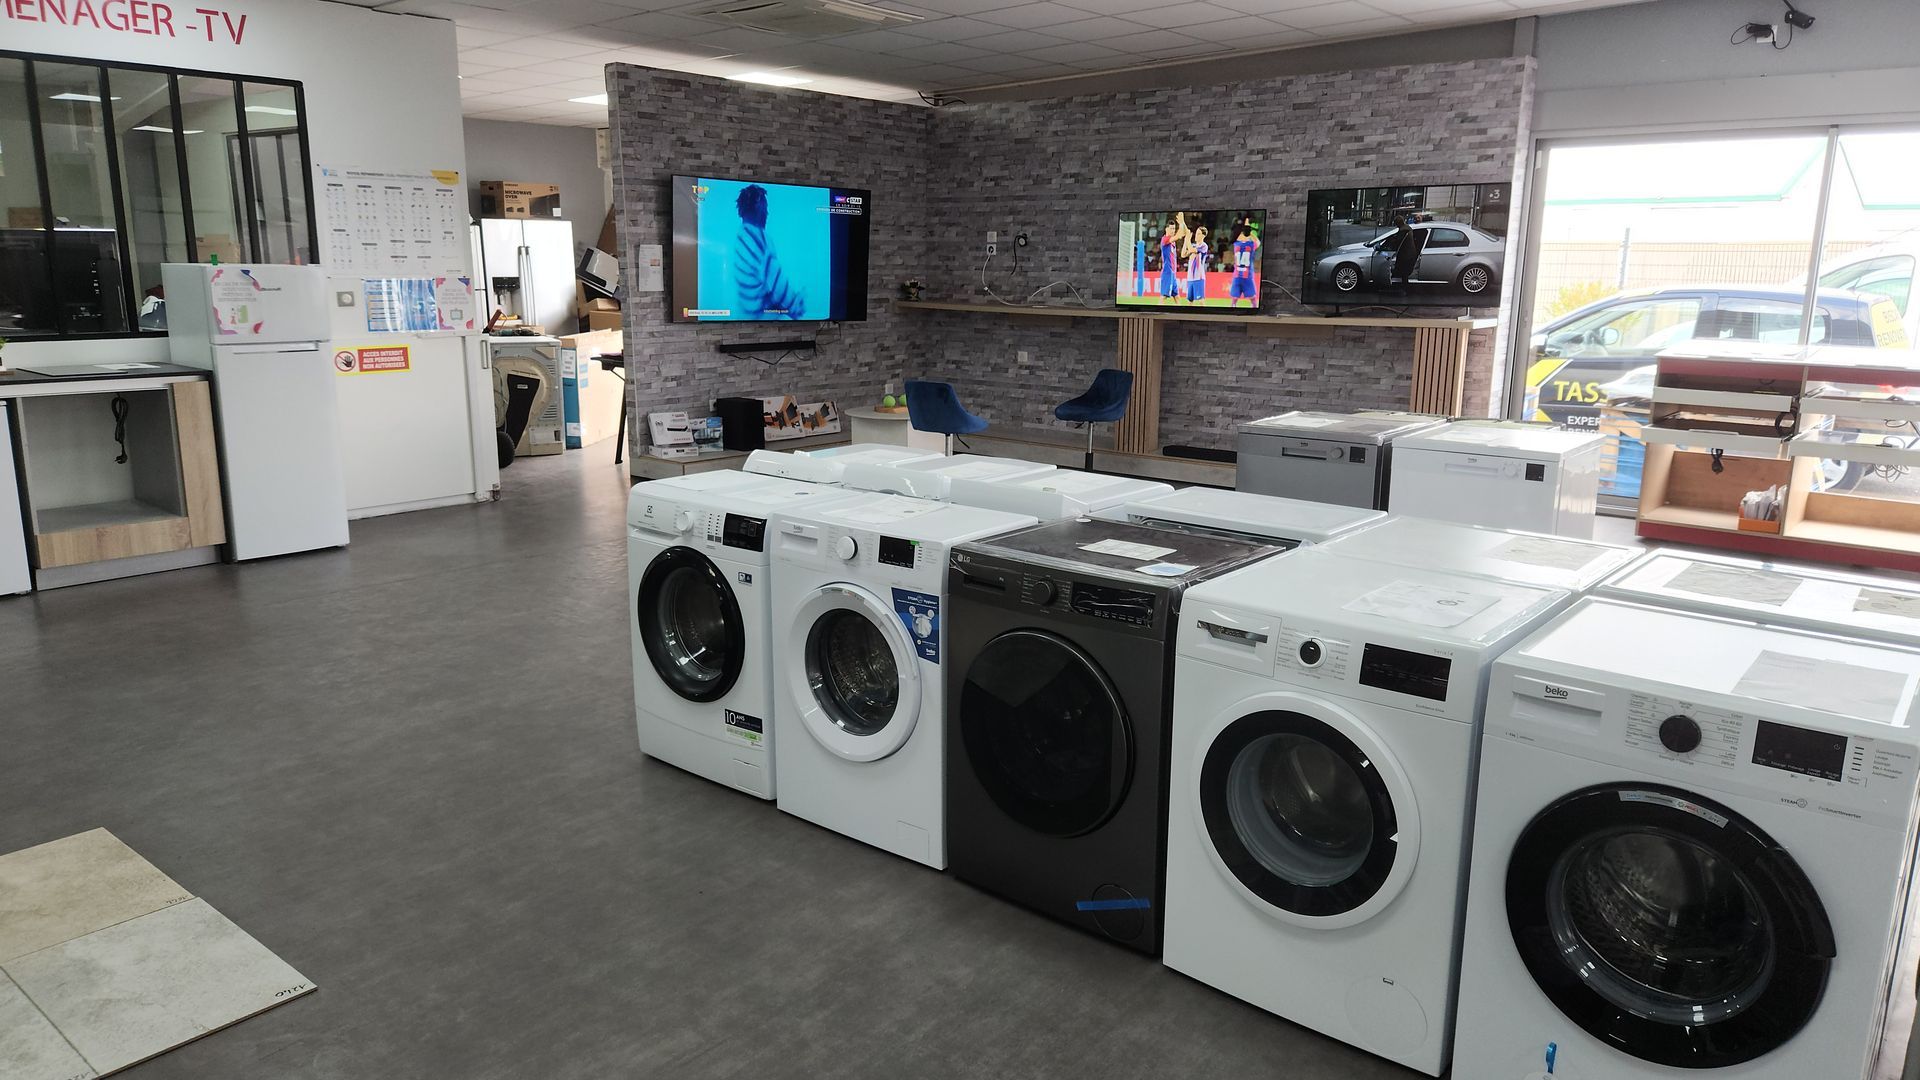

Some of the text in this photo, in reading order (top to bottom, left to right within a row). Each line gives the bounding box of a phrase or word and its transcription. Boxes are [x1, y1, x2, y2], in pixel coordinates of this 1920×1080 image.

[1554, 381, 1608, 403] TAS
[1545, 685, 1569, 698] beko
[726, 710, 736, 725] 10
